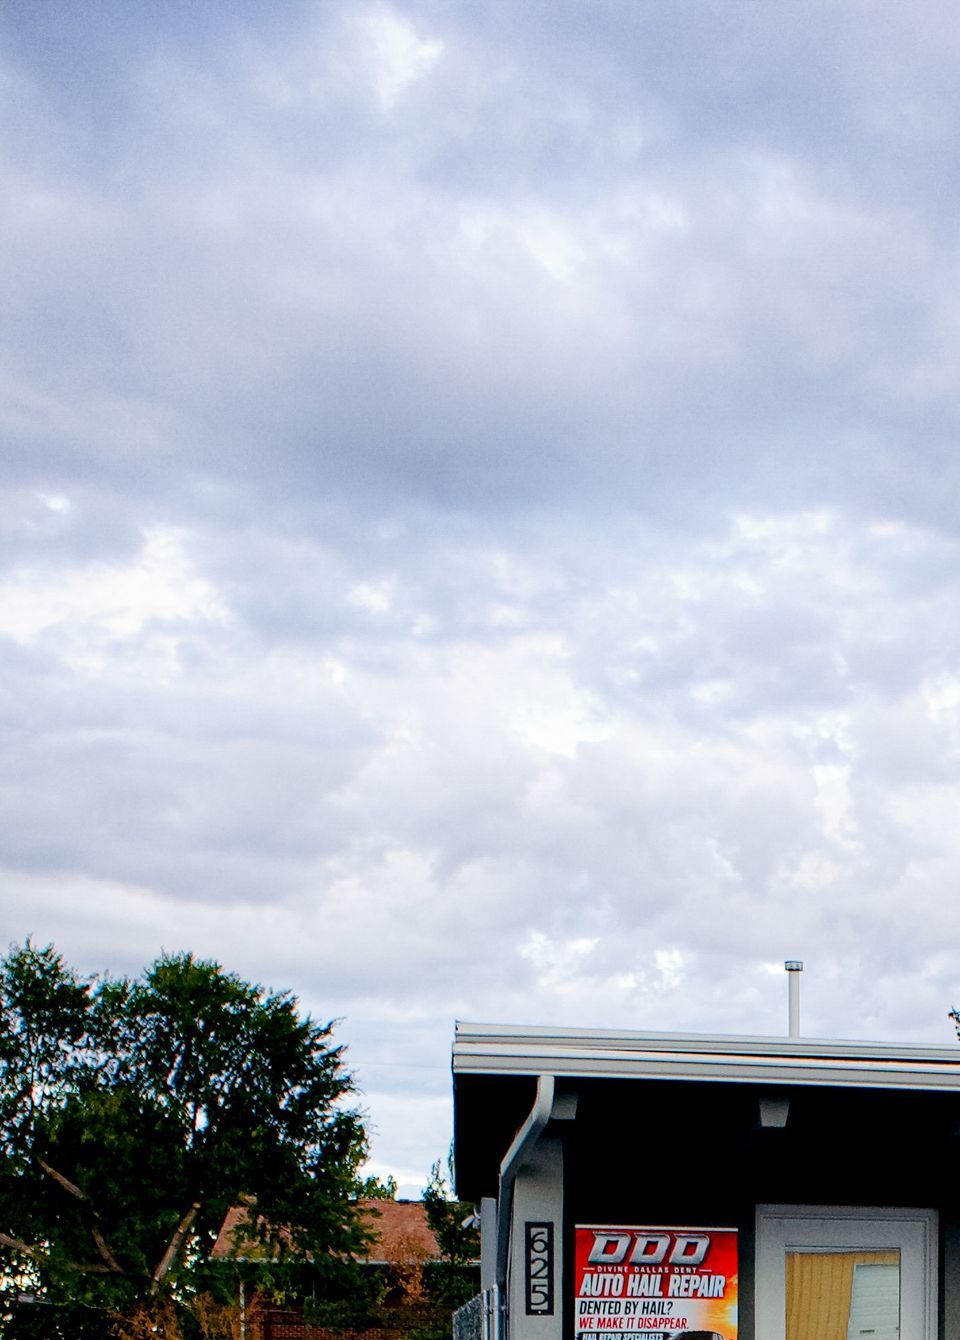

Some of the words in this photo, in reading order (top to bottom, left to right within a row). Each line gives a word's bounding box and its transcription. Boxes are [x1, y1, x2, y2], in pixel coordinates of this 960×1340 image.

[588, 1231, 711, 1264] DDD
[530, 1231, 548, 1305] 625
[579, 1273, 624, 1296] AUTO
[627, 1274, 663, 1297] HAIL
[668, 1274, 726, 1297] REPAIR
[579, 1301, 621, 1315] DENTED
[624, 1301, 639, 1315] BY
[642, 1301, 673, 1316] HAIL?
[579, 1317, 594, 1329] WE
[597, 1317, 624, 1329] MAKE
[627, 1317, 635, 1329] IT
[638, 1317, 689, 1329] DISAPPEAR.
[623, 1332, 664, 1340] SPECIALISTS
